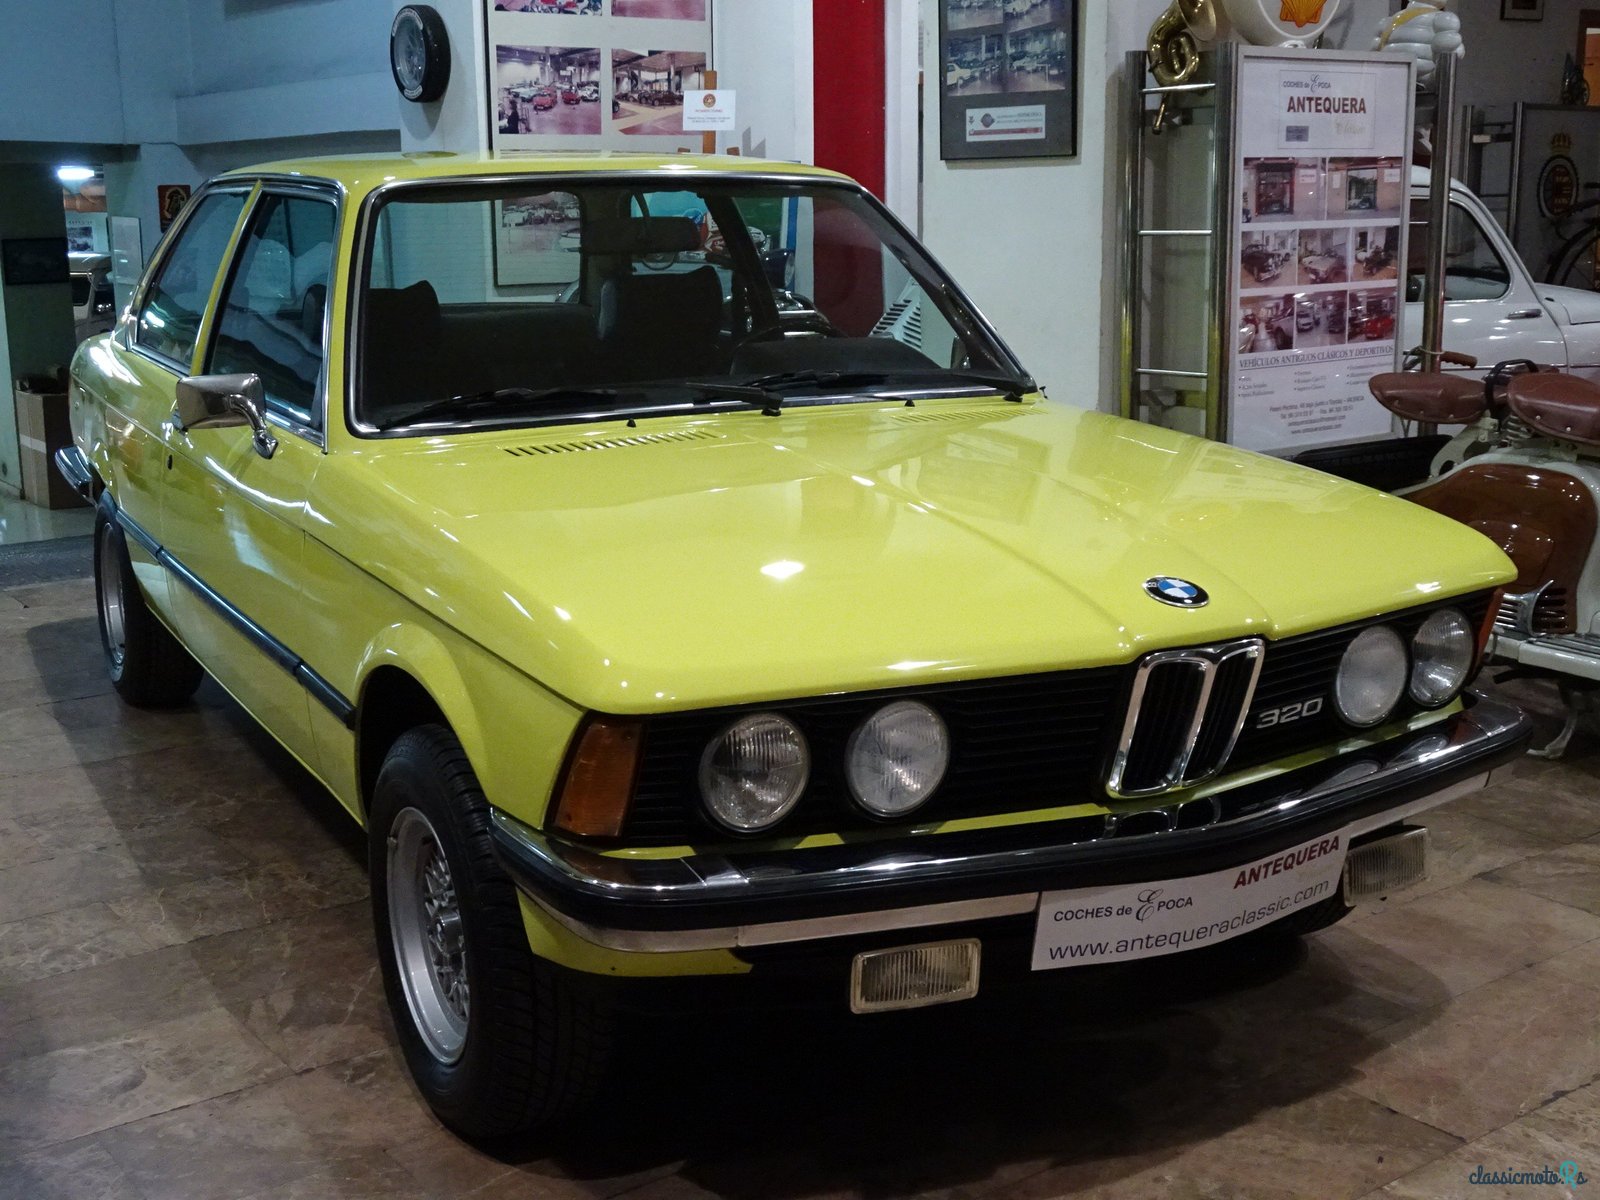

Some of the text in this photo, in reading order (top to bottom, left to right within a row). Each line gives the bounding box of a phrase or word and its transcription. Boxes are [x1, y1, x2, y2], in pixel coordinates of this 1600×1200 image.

[1287, 96, 1367, 114] ANTEQUERA
[1280, 352, 1317, 364] ANTIGUOS
[1350, 348, 1355, 357] Y
[1355, 345, 1394, 357] DEPORTIVOS
[1256, 697, 1323, 729] 320
[1233, 835, 1340, 889] ANTEQUERA
[1049, 879, 1329, 960] www.antequeraclassic.com
[1053, 905, 1113, 922] COCHES
[1116, 905, 1133, 917] de
